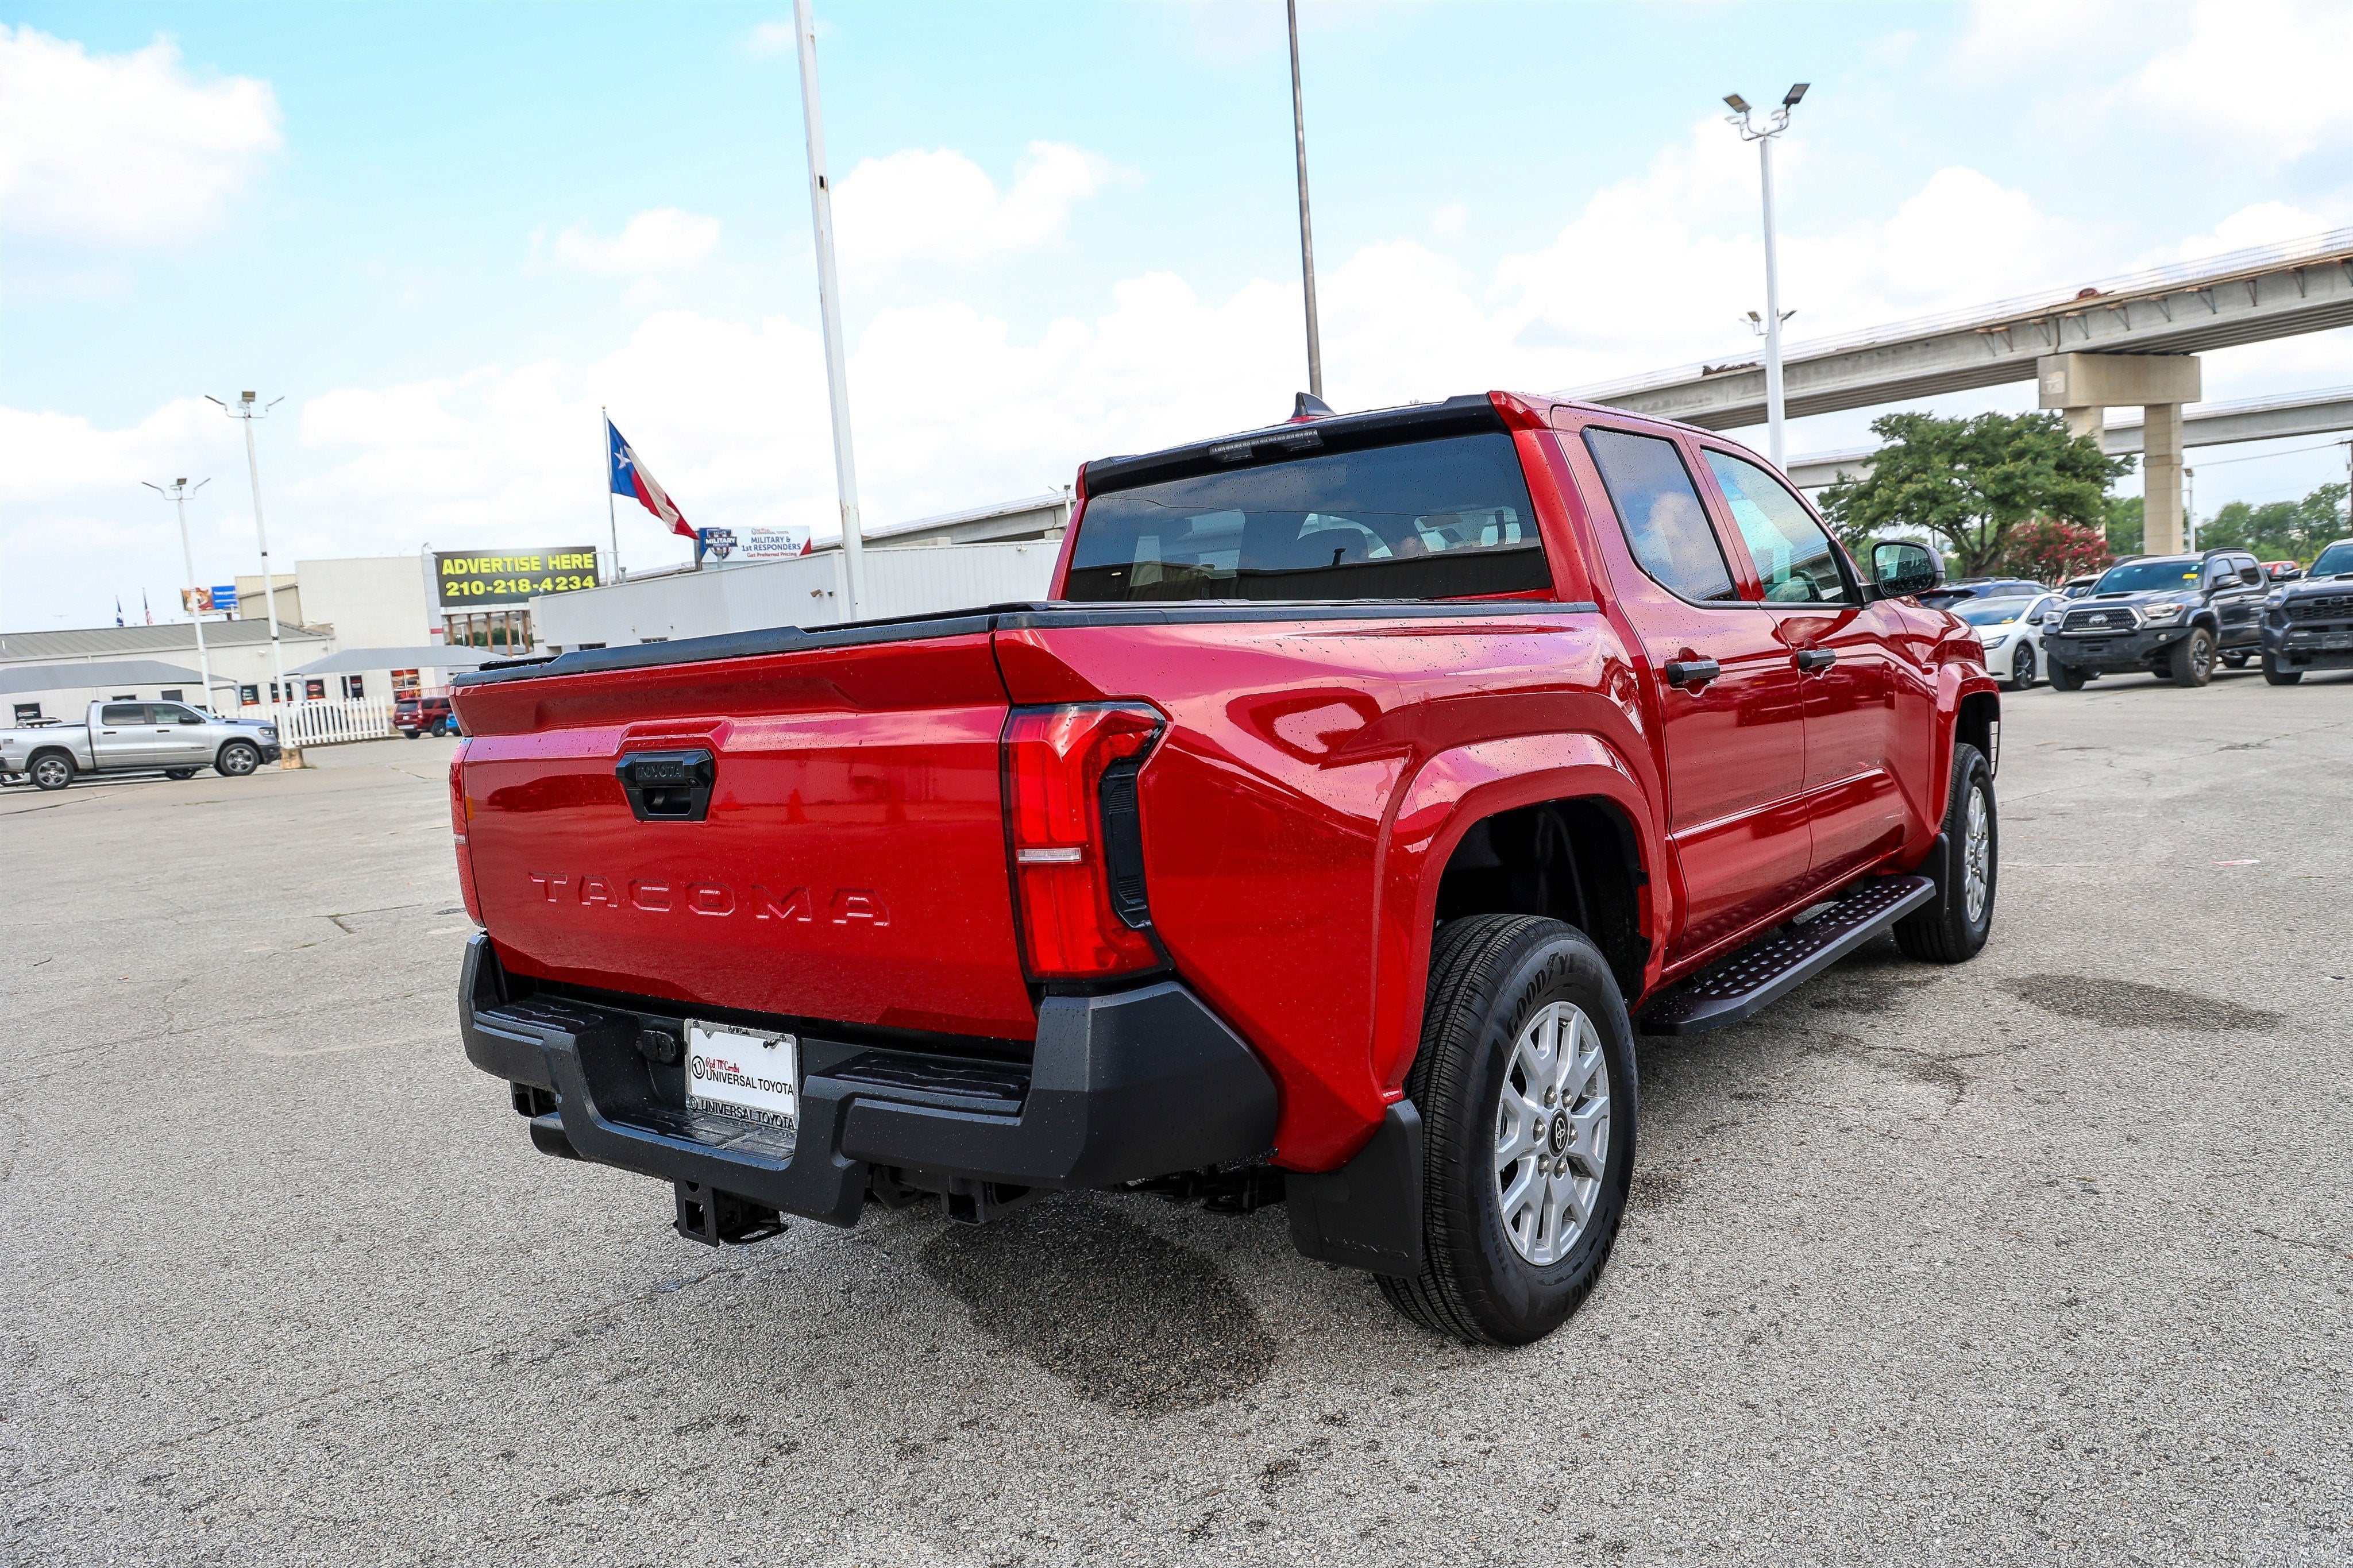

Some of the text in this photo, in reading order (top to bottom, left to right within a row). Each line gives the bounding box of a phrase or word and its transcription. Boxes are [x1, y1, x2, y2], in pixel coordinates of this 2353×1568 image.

[442, 553, 595, 576] ADVERTISE HERE
[445, 575, 596, 597] 210-218-4234
[638, 764, 681, 778] TOYOTA
[529, 871, 890, 927] TACOMA
[705, 1057, 739, 1073] Red McCombs
[706, 1069, 794, 1095] UNIVERSAL TOYOTA
[701, 1099, 755, 1120] UNIVERSAL
[756, 1110, 794, 1129] TOYOTA
[1485, 1166, 1509, 1275] TERRITORY
